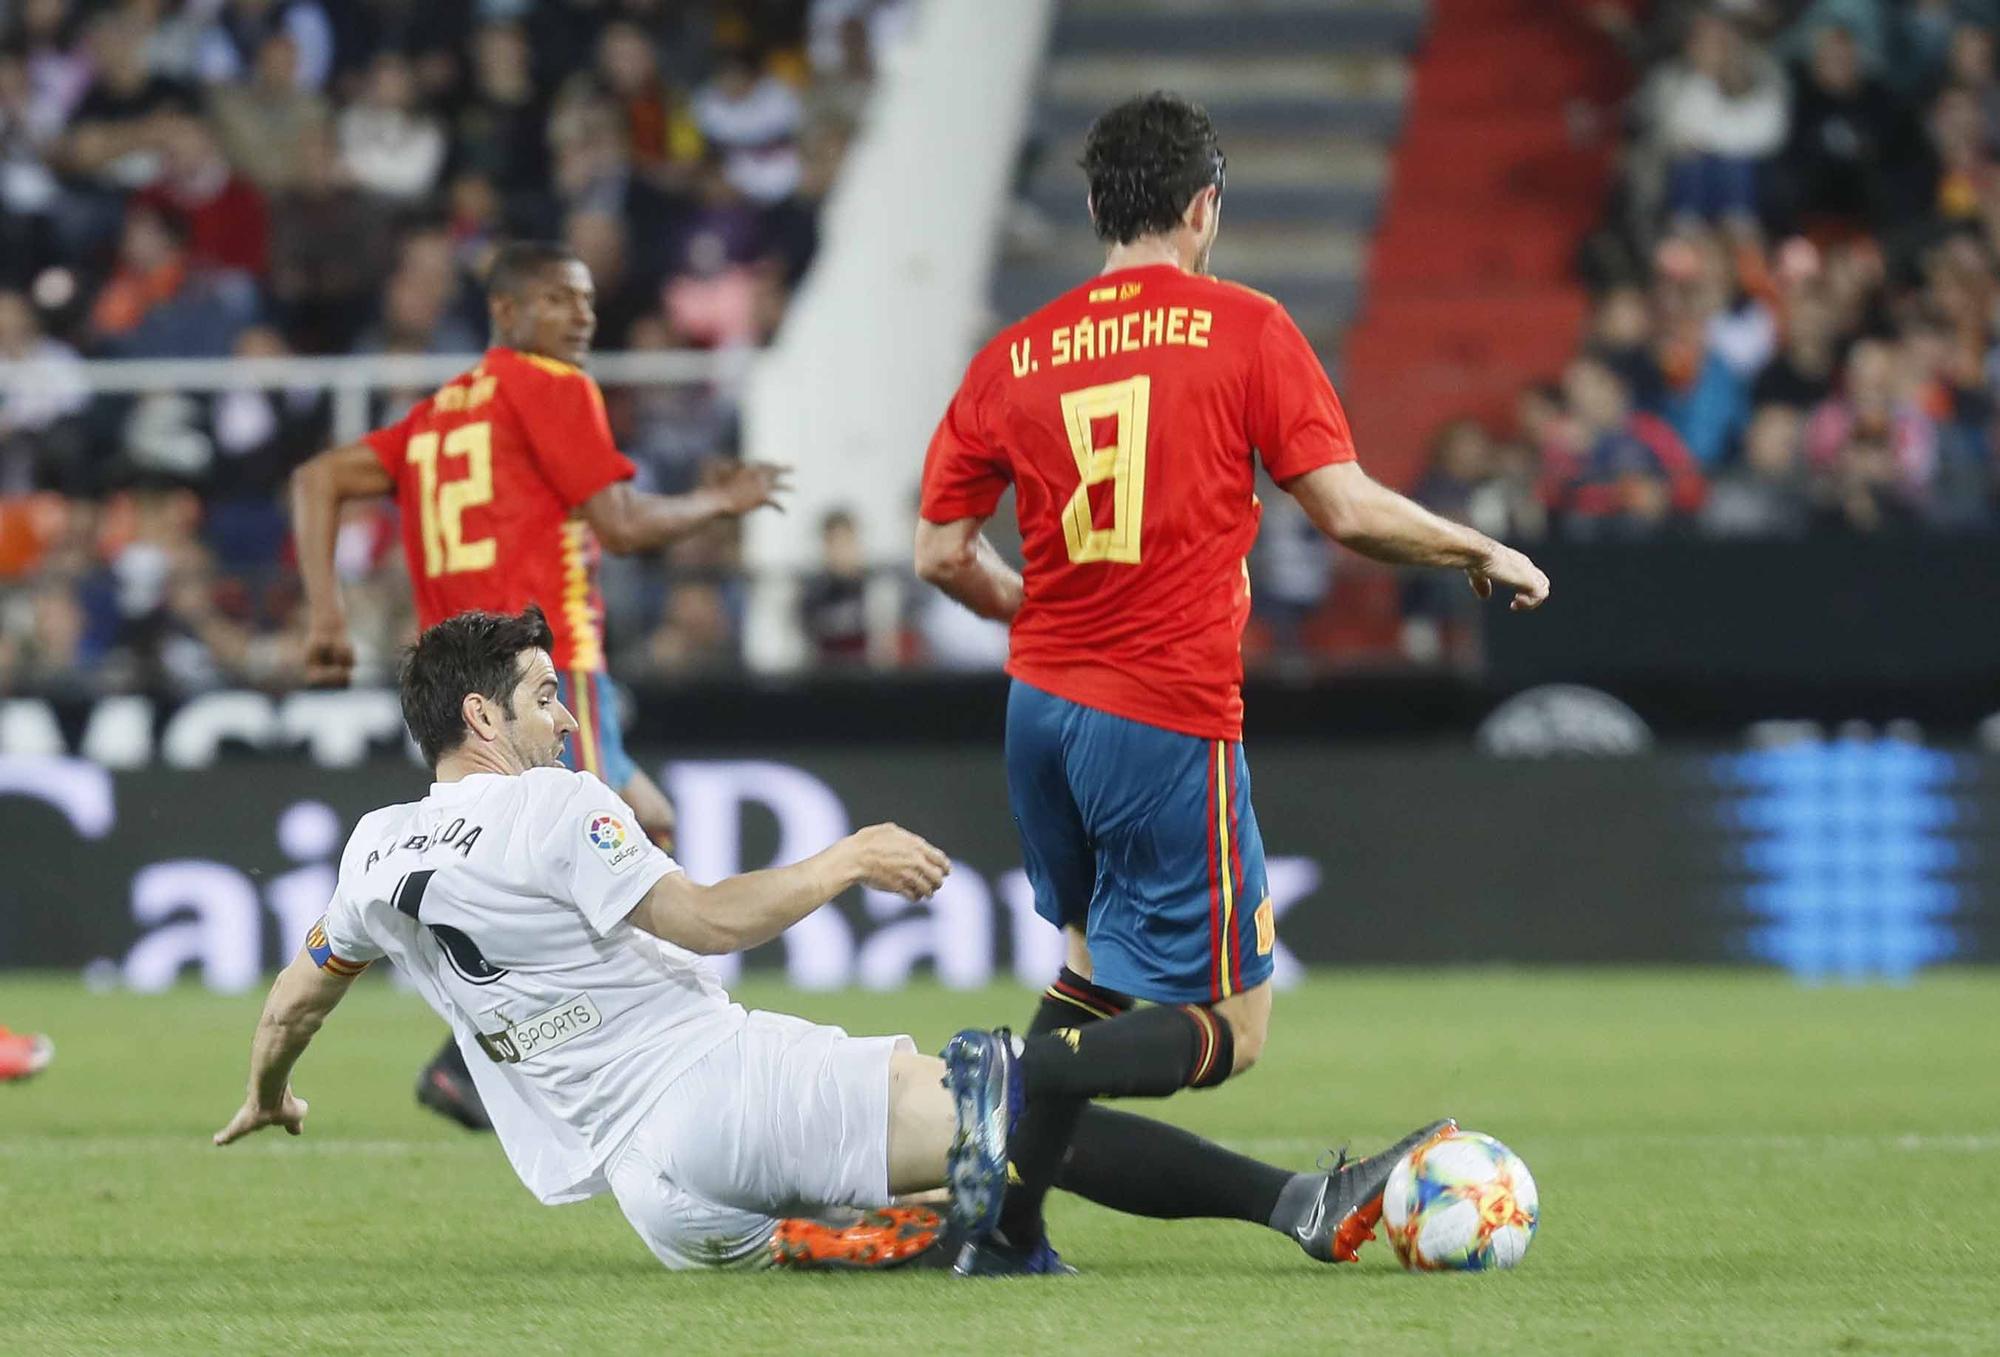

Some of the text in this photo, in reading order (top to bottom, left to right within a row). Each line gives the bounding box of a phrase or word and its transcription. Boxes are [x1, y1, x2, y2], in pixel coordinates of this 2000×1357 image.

[1051, 307, 1213, 367] SÁNCHEZ
[406, 421, 497, 577] 12
[1060, 375, 1151, 564] 8
[517, 1004, 592, 1051] SPORTS
